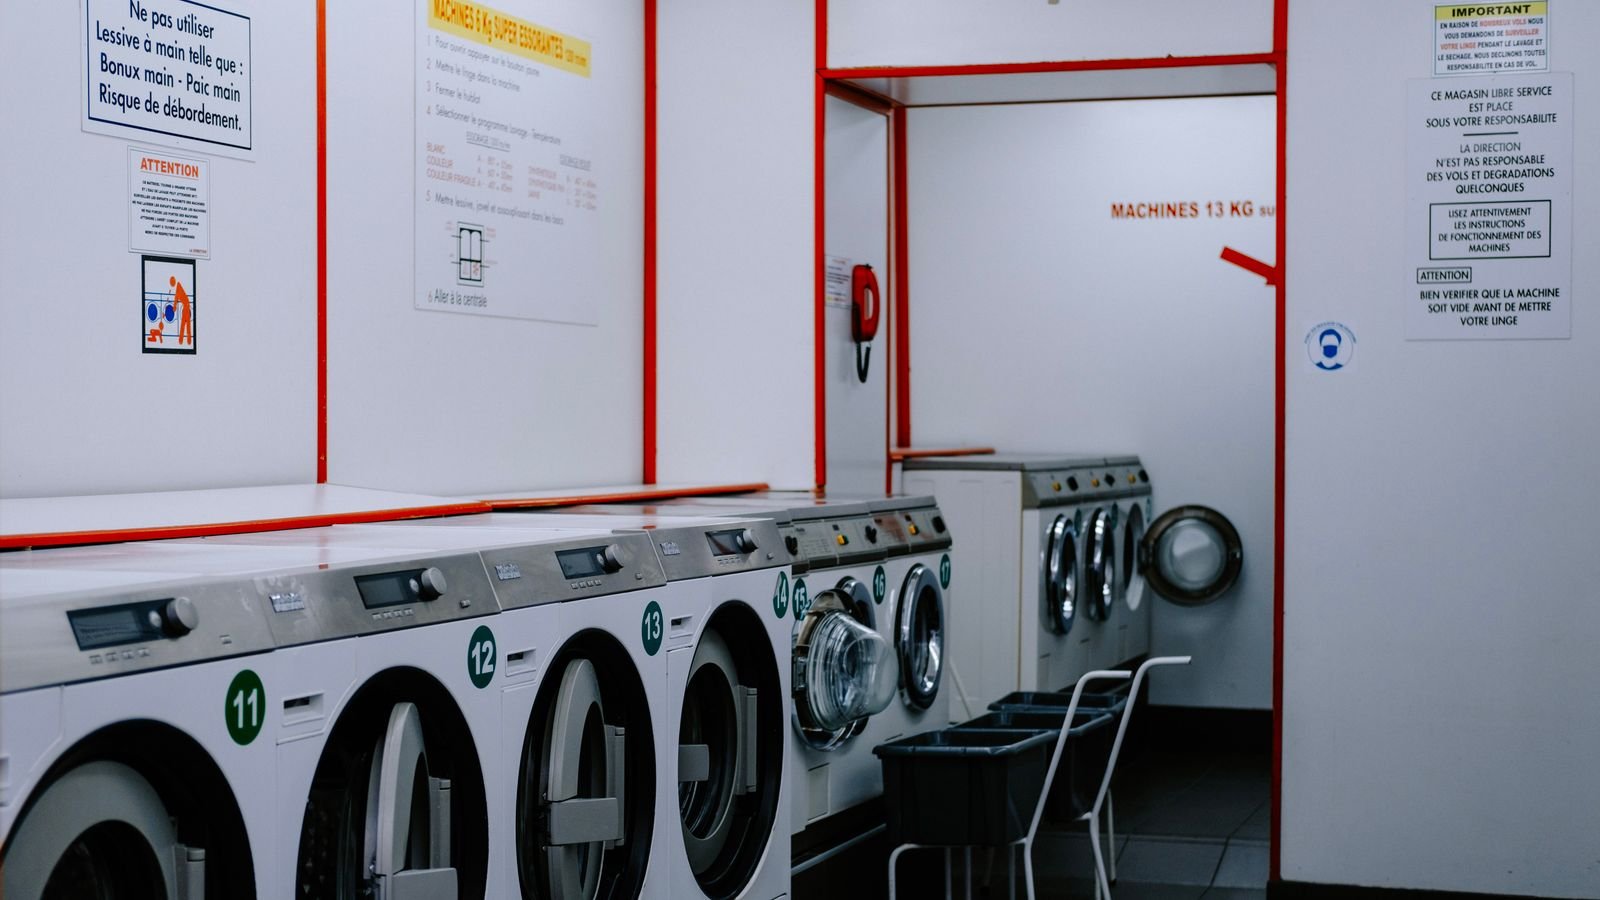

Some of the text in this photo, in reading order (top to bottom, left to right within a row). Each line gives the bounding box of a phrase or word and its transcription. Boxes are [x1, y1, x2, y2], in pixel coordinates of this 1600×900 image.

[1452, 5, 1531, 17] IMPORTANT
[130, 0, 214, 39] Ne pas utiliser
[433, 0, 474, 30] MACHINES
[476, 9, 480, 32] 6
[482, 11, 492, 43] Kg
[494, 16, 517, 45] SUPER
[520, 25, 563, 60] ESSORANTES
[1444, 32, 1459, 40] VOUS
[1461, 30, 1494, 39] DEMANDONS
[97, 20, 243, 76] Lessive à main telle que :
[1491, 50, 1522, 58] DECLINONS
[101, 52, 140, 80] Bonux
[145, 67, 173, 87] main
[187, 73, 209, 96] Paic
[213, 83, 240, 102] main
[426, 58, 431, 69] 2
[435, 59, 453, 74] Mettre
[455, 63, 460, 75] le
[462, 65, 476, 82] linge
[478, 70, 490, 84] dans
[435, 82, 455, 98] Fermer
[457, 88, 462, 100] le
[1431, 86, 1552, 101] CE MAGASIN LIBRE SERVICE
[100, 83, 241, 131] Risque de débordement.
[1469, 102, 1512, 112] EST PLACE
[1426, 113, 1557, 128] SOUS VOTRE RESPONSABILITE
[1460, 142, 1521, 153] LA DIRECTION
[140, 158, 198, 177] ATTENTION
[1436, 155, 1544, 167] N'EST PAS RESPONSABLE
[1427, 168, 1554, 181] DES VOLS ET DEGRADATIONS
[1456, 182, 1524, 194] QUELCONQUES
[426, 190, 431, 201] 5
[435, 193, 453, 206] Mettre
[1112, 202, 1198, 218] MACHINES
[1206, 202, 1223, 217] 13
[1230, 201, 1253, 217] KG
[1449, 207, 1531, 218] LISEZ ATTENTIVEMENT
[1454, 219, 1525, 229] LES INSTRUCTIONS
[1451, 232, 1524, 241] FONCTIONNEMENT
[1527, 231, 1541, 239] DES
[1469, 244, 1510, 252] MACHINES
[1420, 271, 1469, 280] ATTENTION
[434, 288, 449, 303] Aller
[451, 291, 454, 304] à
[456, 291, 461, 305] la
[464, 292, 487, 308] centrale
[1420, 288, 1560, 300] BIEN VERIFIER QUE LA MACHINE
[1428, 302, 1551, 313] SOIT VIDE AVANT DE METTRE
[1461, 316, 1517, 326] VOTRE LINGE
[941, 562, 950, 578] 17
[875, 574, 884, 593] 16
[776, 578, 787, 609] 14
[795, 587, 805, 612] 15
[645, 611, 660, 641] 13
[472, 640, 494, 675] 12
[233, 688, 258, 729] 11
